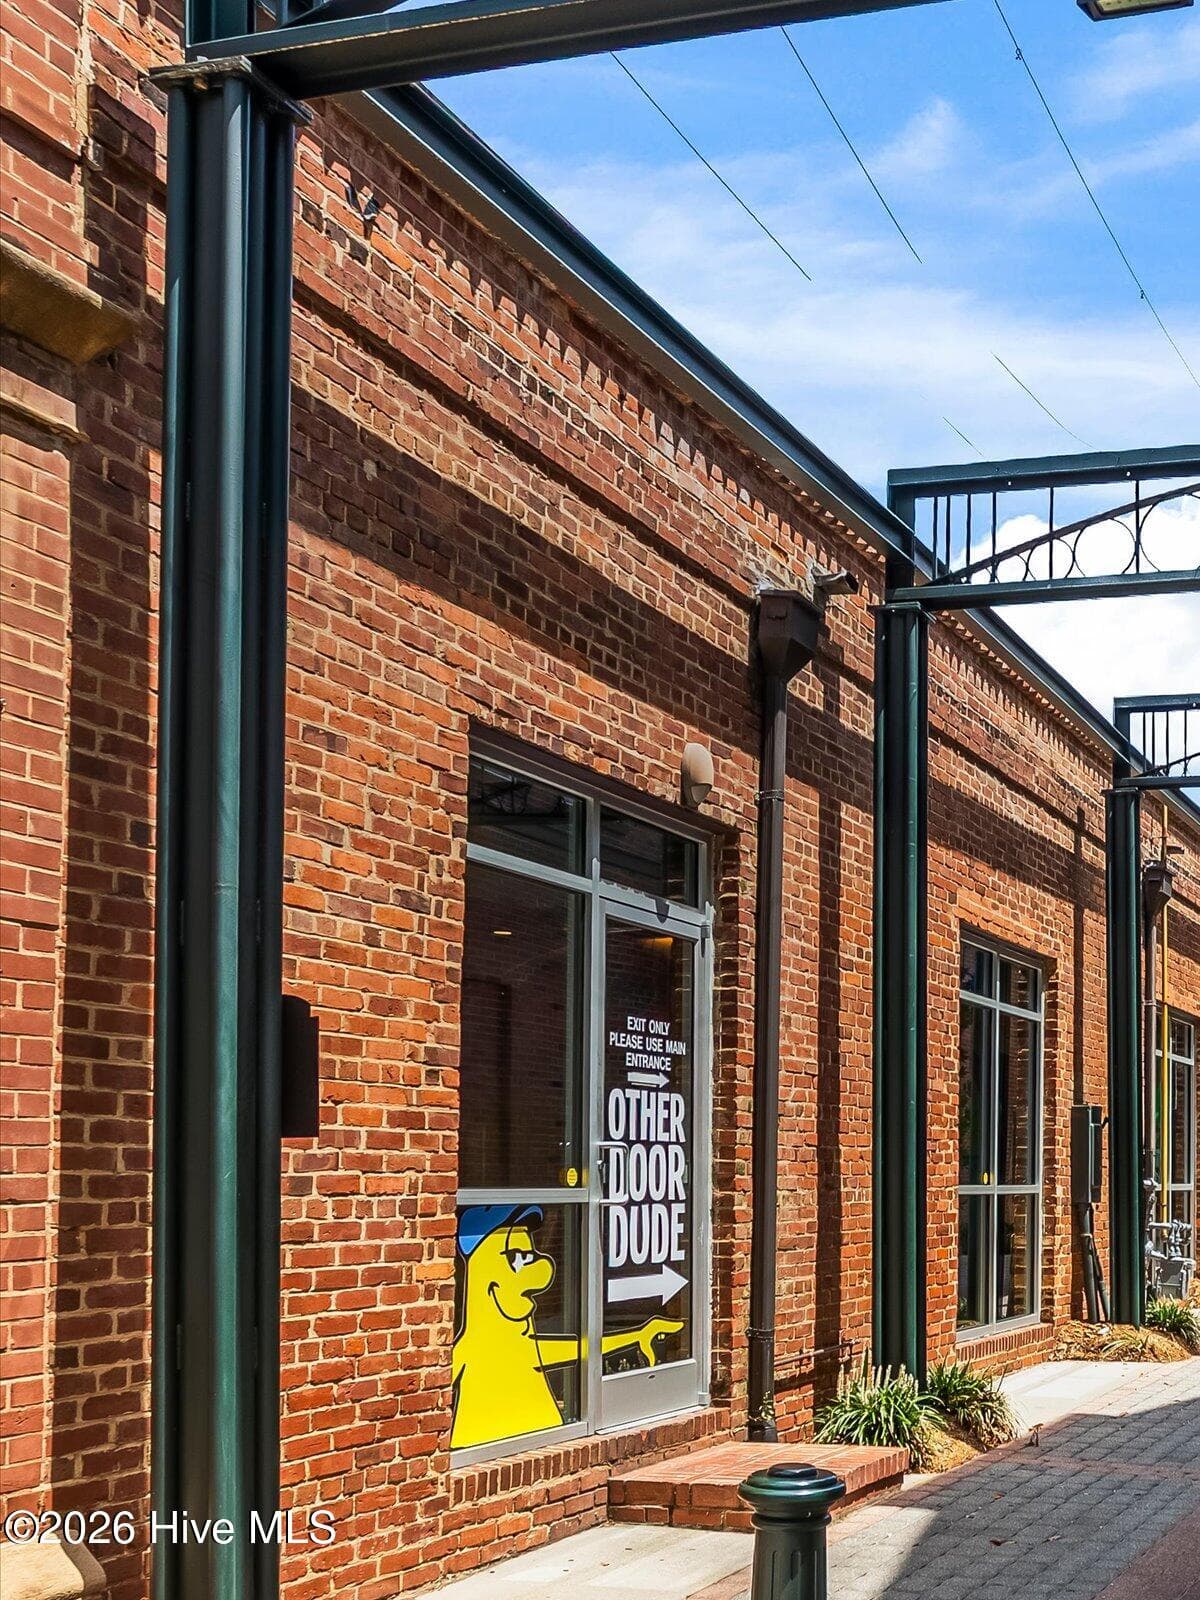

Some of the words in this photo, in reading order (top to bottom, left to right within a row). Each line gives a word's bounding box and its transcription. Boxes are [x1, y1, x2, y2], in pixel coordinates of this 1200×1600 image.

[609, 1031, 643, 1050] PLEASE
[646, 1036, 663, 1052] USE
[665, 1040, 686, 1056] MAIN
[627, 1016, 646, 1032] EXIT
[649, 1020, 670, 1036] ONLY
[626, 1052, 671, 1071] ENTRANCE
[608, 1088, 686, 1143] OTHER
[609, 1144, 686, 1202] DOOR
[608, 1202, 686, 1268] DUDE
